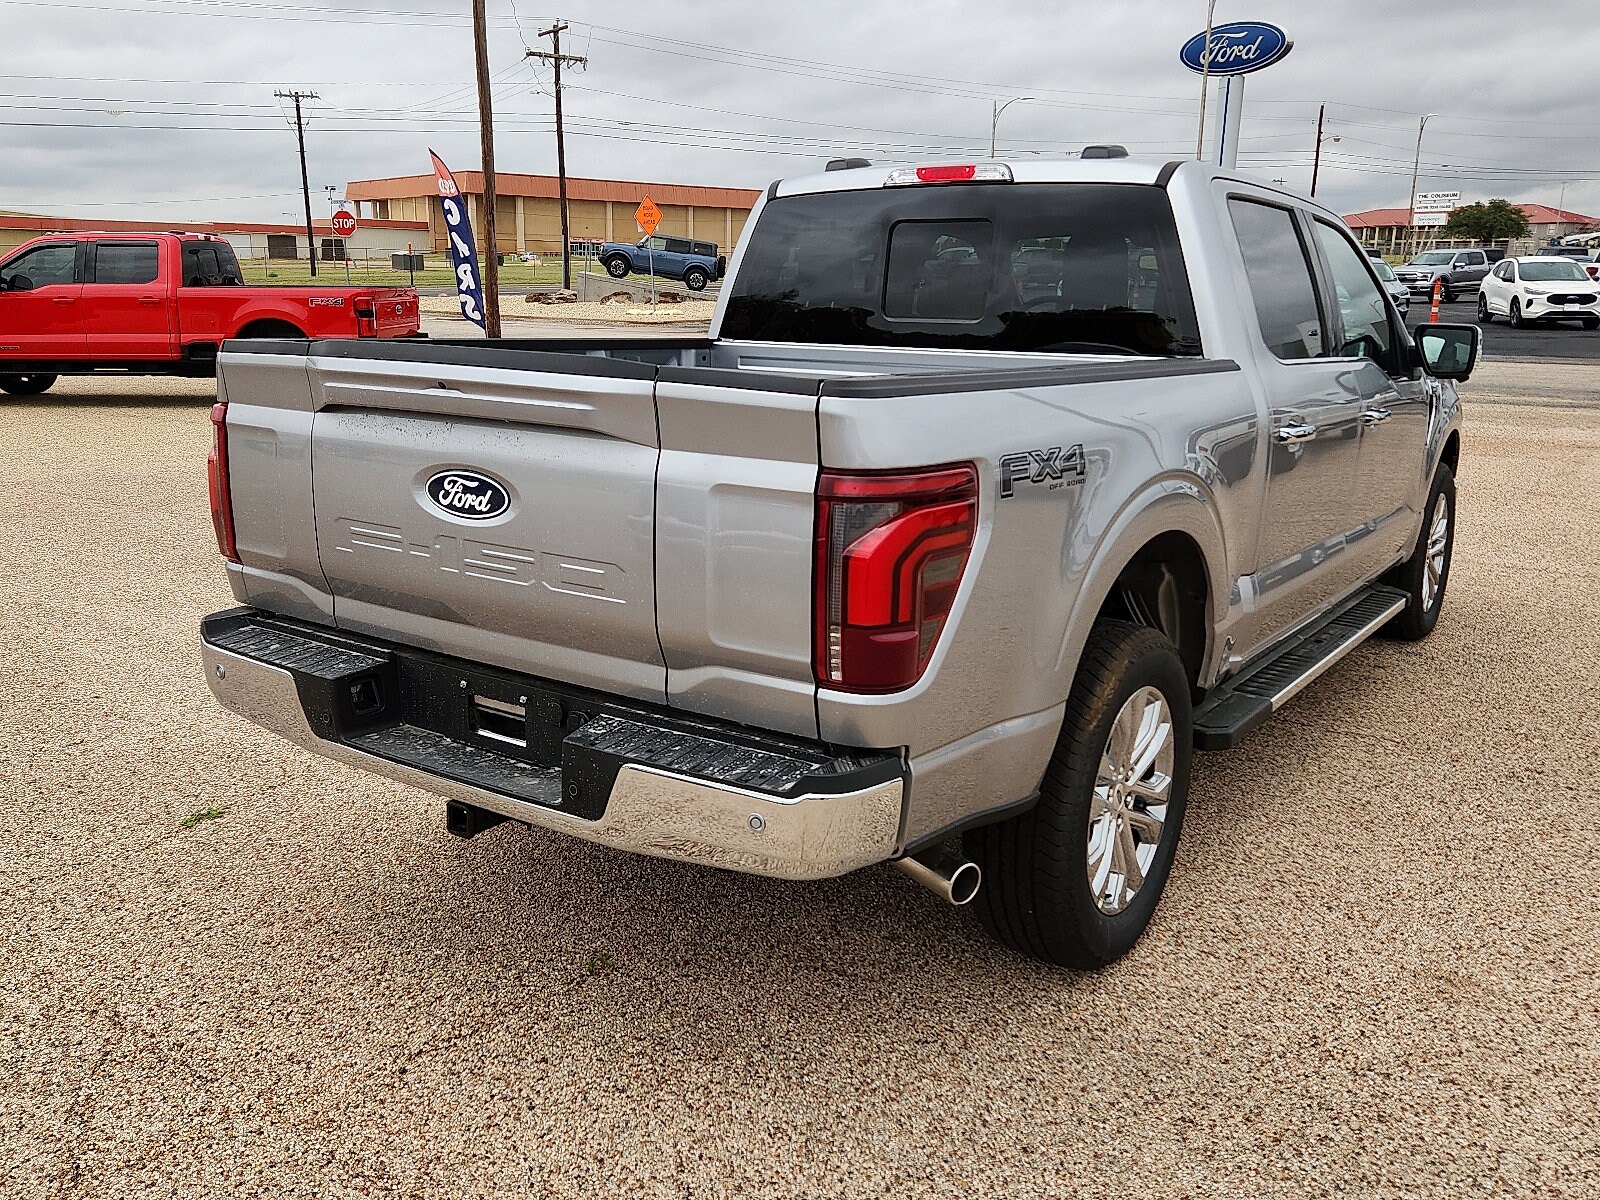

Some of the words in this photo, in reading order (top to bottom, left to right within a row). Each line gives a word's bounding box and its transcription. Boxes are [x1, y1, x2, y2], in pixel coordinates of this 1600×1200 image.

[1200, 31, 1264, 64] Ford
[333, 218, 355, 229] STOP
[309, 297, 345, 308] FX4
[999, 444, 1085, 499] FX4
[1049, 482, 1066, 491] OFF
[438, 476, 492, 511] Ford
[334, 516, 627, 604] F-150
